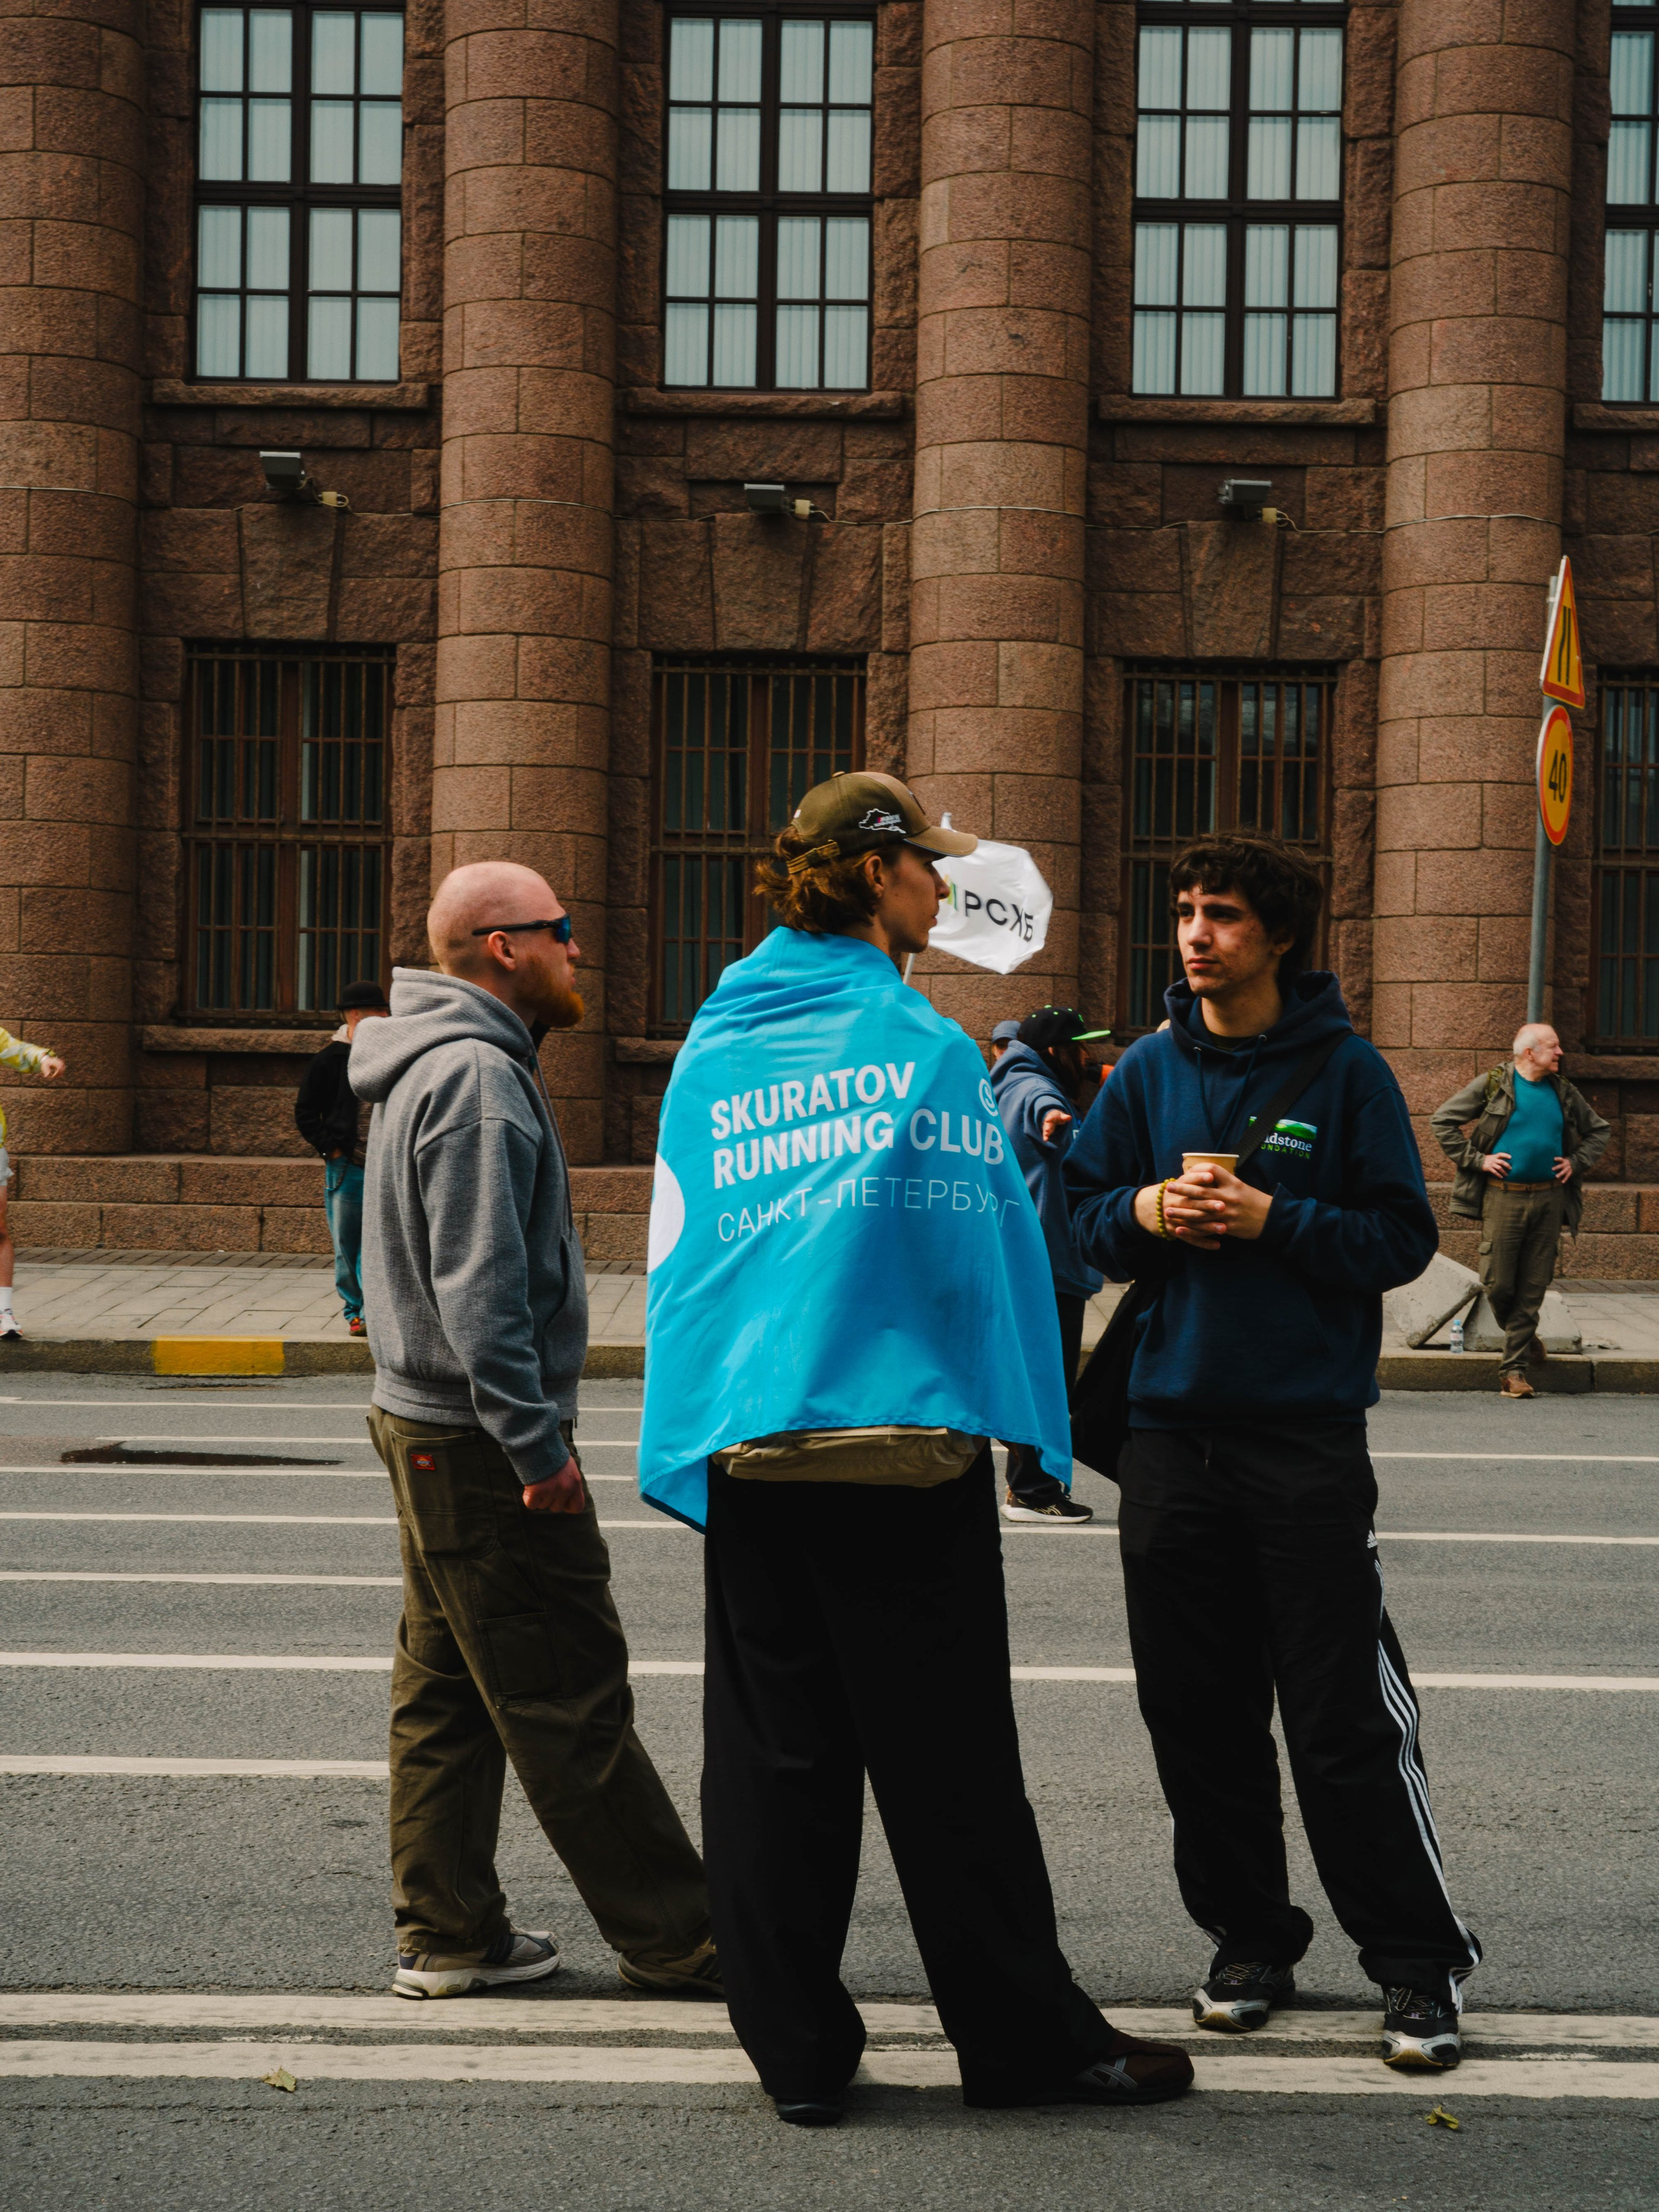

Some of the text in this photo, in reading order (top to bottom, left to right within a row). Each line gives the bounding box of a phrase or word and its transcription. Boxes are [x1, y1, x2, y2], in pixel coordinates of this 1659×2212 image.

[1548, 749, 1567, 804] 40
[964, 889, 1034, 942] РСХБ
[710, 1061, 916, 1141] SKURATOV
[713, 1108, 1004, 1189] RUNNING CLUB
[1260, 1143, 1310, 1159] UNDATION
